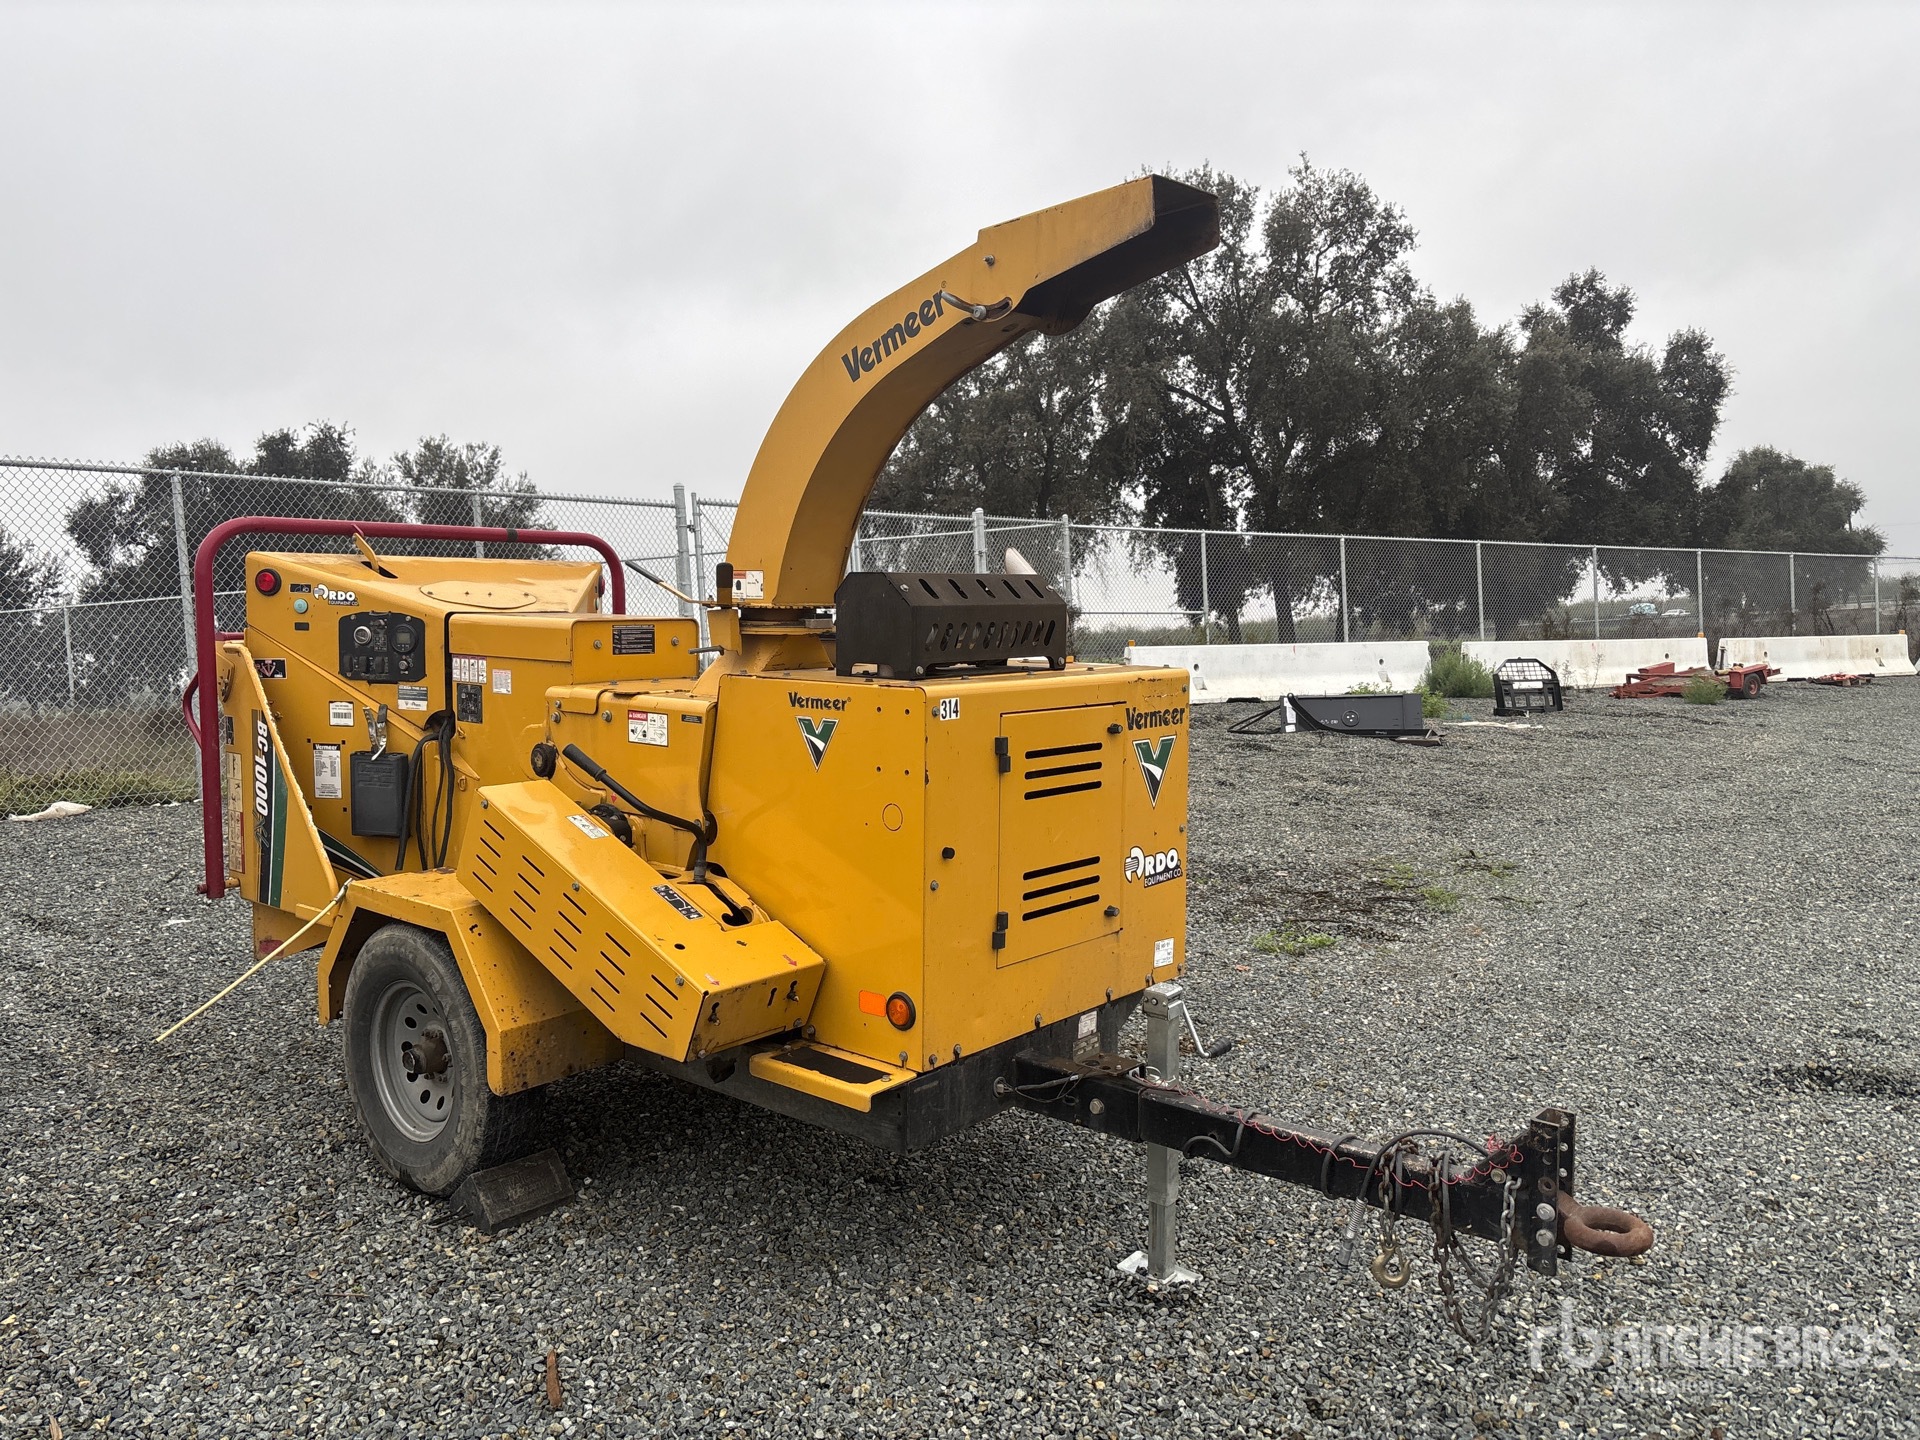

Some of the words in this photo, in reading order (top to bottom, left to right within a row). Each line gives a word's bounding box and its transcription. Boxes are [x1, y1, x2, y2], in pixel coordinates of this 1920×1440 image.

[841, 290, 944, 383] Vermeer
[788, 691, 847, 712] Vermeer
[941, 698, 959, 720] 314
[1125, 706, 1185, 731] Vermeer
[257, 720, 269, 753] BC
[254, 754, 269, 817] 1000
[1144, 870, 1174, 887] EQUIPMENT
